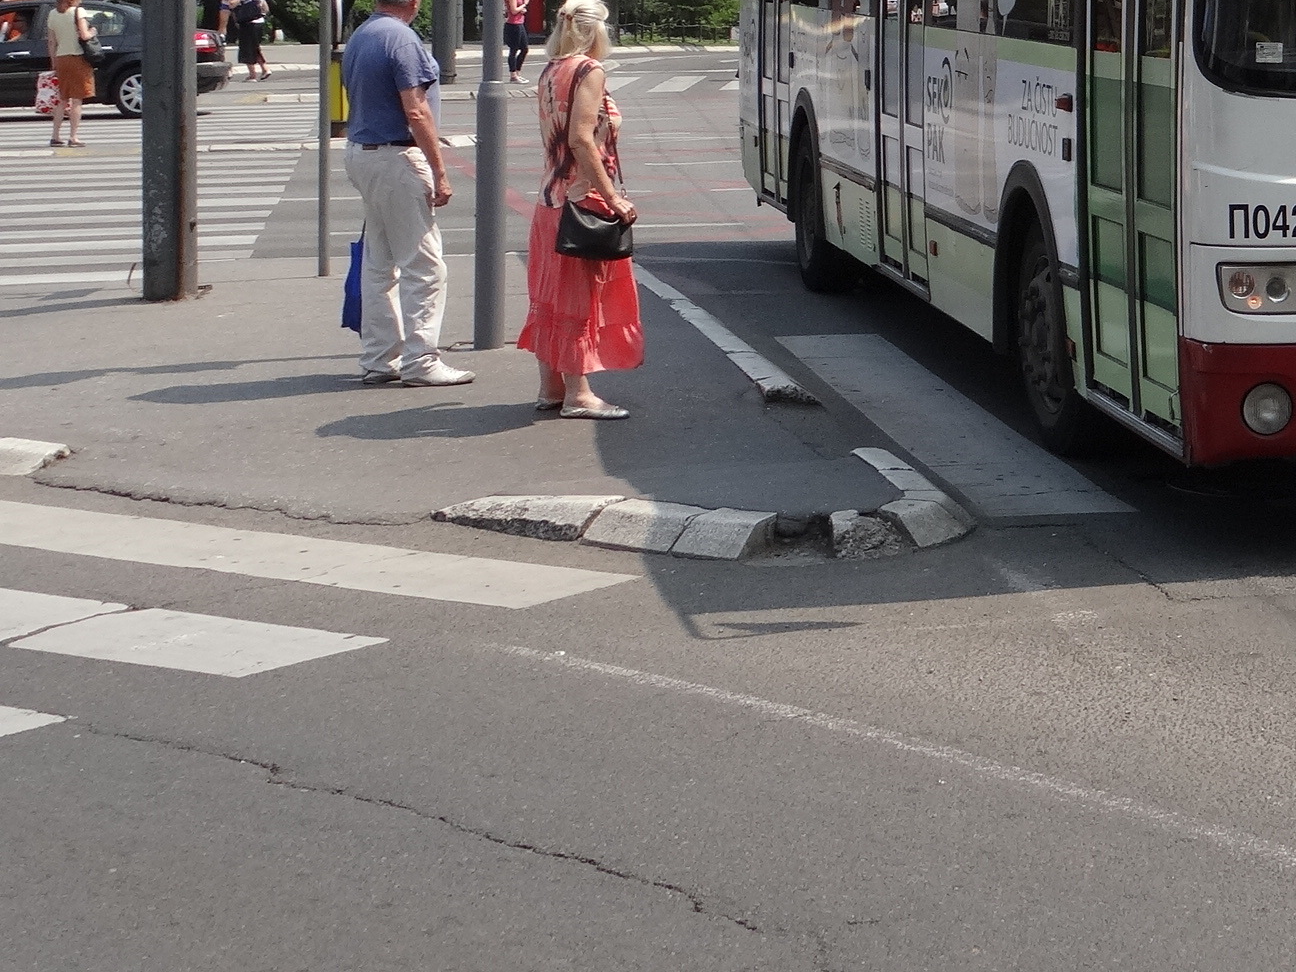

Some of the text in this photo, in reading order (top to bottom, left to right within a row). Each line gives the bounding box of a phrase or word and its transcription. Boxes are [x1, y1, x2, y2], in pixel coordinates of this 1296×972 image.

[1021, 76, 1058, 117] ZA ČISTU
[926, 123, 946, 164] PAK
[1007, 112, 1058, 157] BUDUĆNOST
